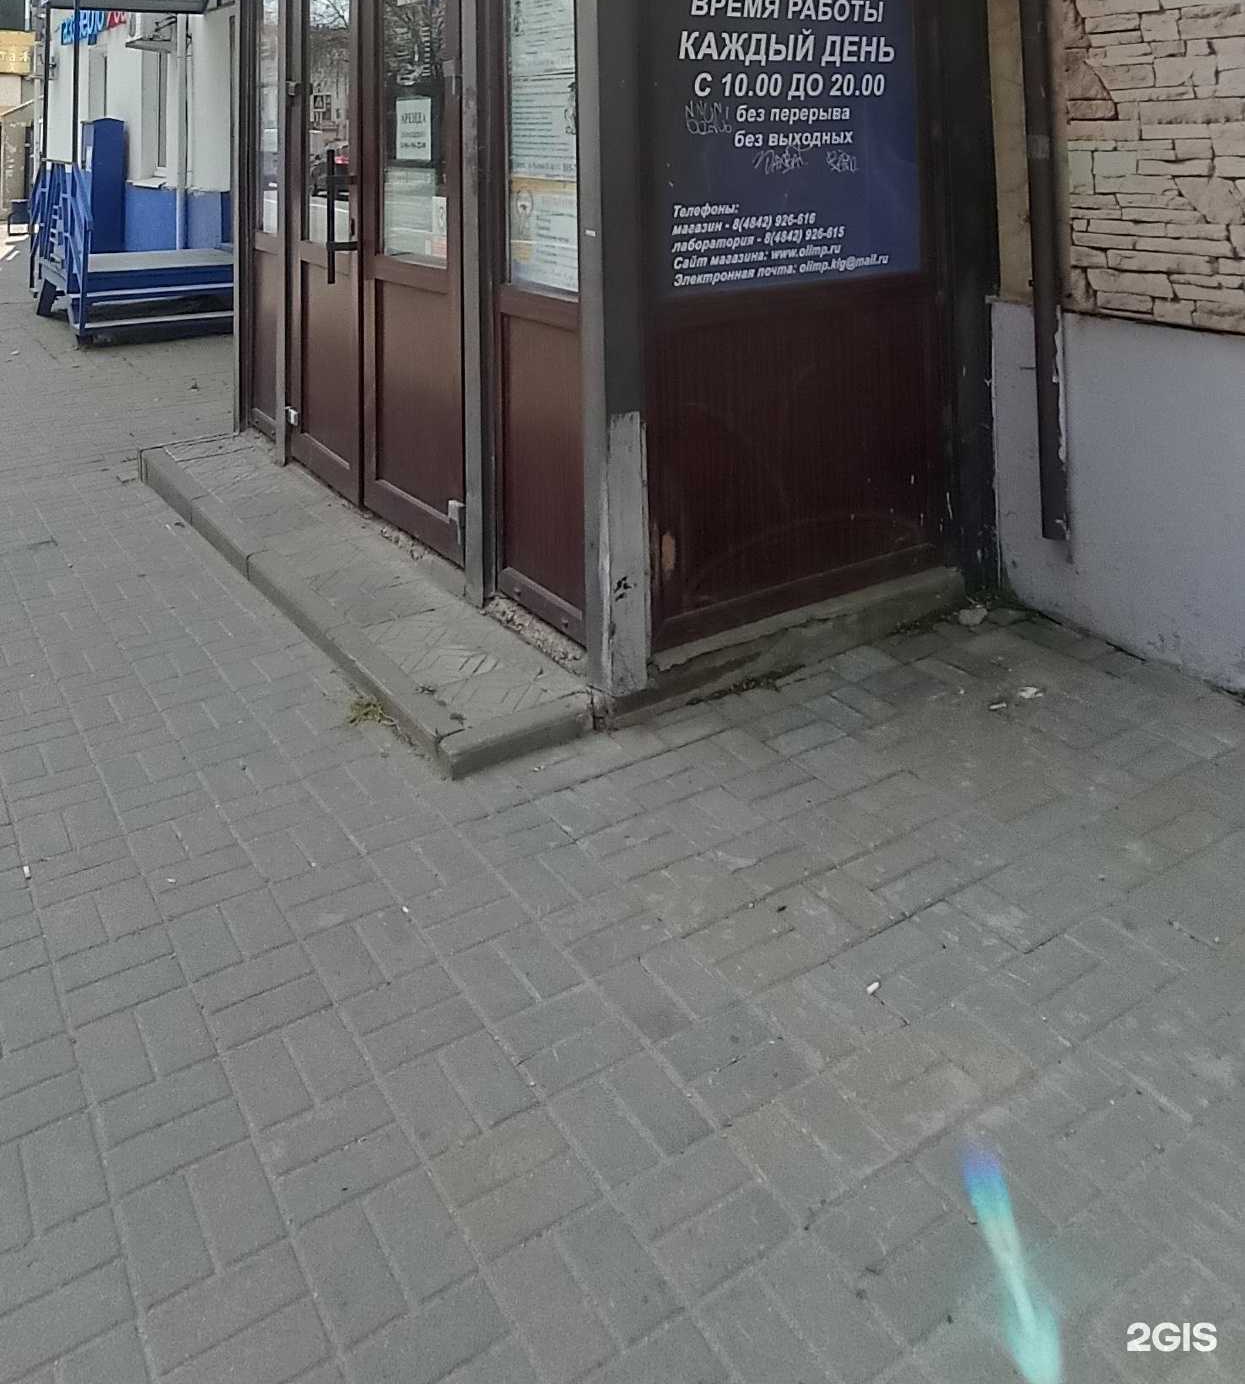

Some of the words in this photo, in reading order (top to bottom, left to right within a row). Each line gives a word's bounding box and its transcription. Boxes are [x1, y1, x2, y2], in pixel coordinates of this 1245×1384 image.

[678, 29, 816, 66] КАЖДЫЙ
[821, 35, 895, 66] ДЕНЬ
[721, 73, 783, 97] 10.00
[787, 73, 823, 100] ДО
[829, 73, 885, 97] 20.00
[736, 105, 765, 122] без
[770, 106, 850, 124] перерыва
[734, 130, 763, 148] без
[768, 130, 853, 148] выходных
[673, 202, 740, 218] Телефоны:
[672, 221, 722, 236] магазин
[732, 215, 772, 232] 8(4842)
[774, 212, 816, 227] 926-616
[672, 235, 754, 253] лаборатория
[763, 229, 803, 246] 8(4842)
[805, 225, 845, 241] 926-615
[674, 255, 708, 270] Сайт
[709, 250, 769, 266] магазина:
[771, 244, 841, 259] www.olimp.ru
[674, 269, 755, 287] Электронная
[757, 263, 797, 277] почта:
